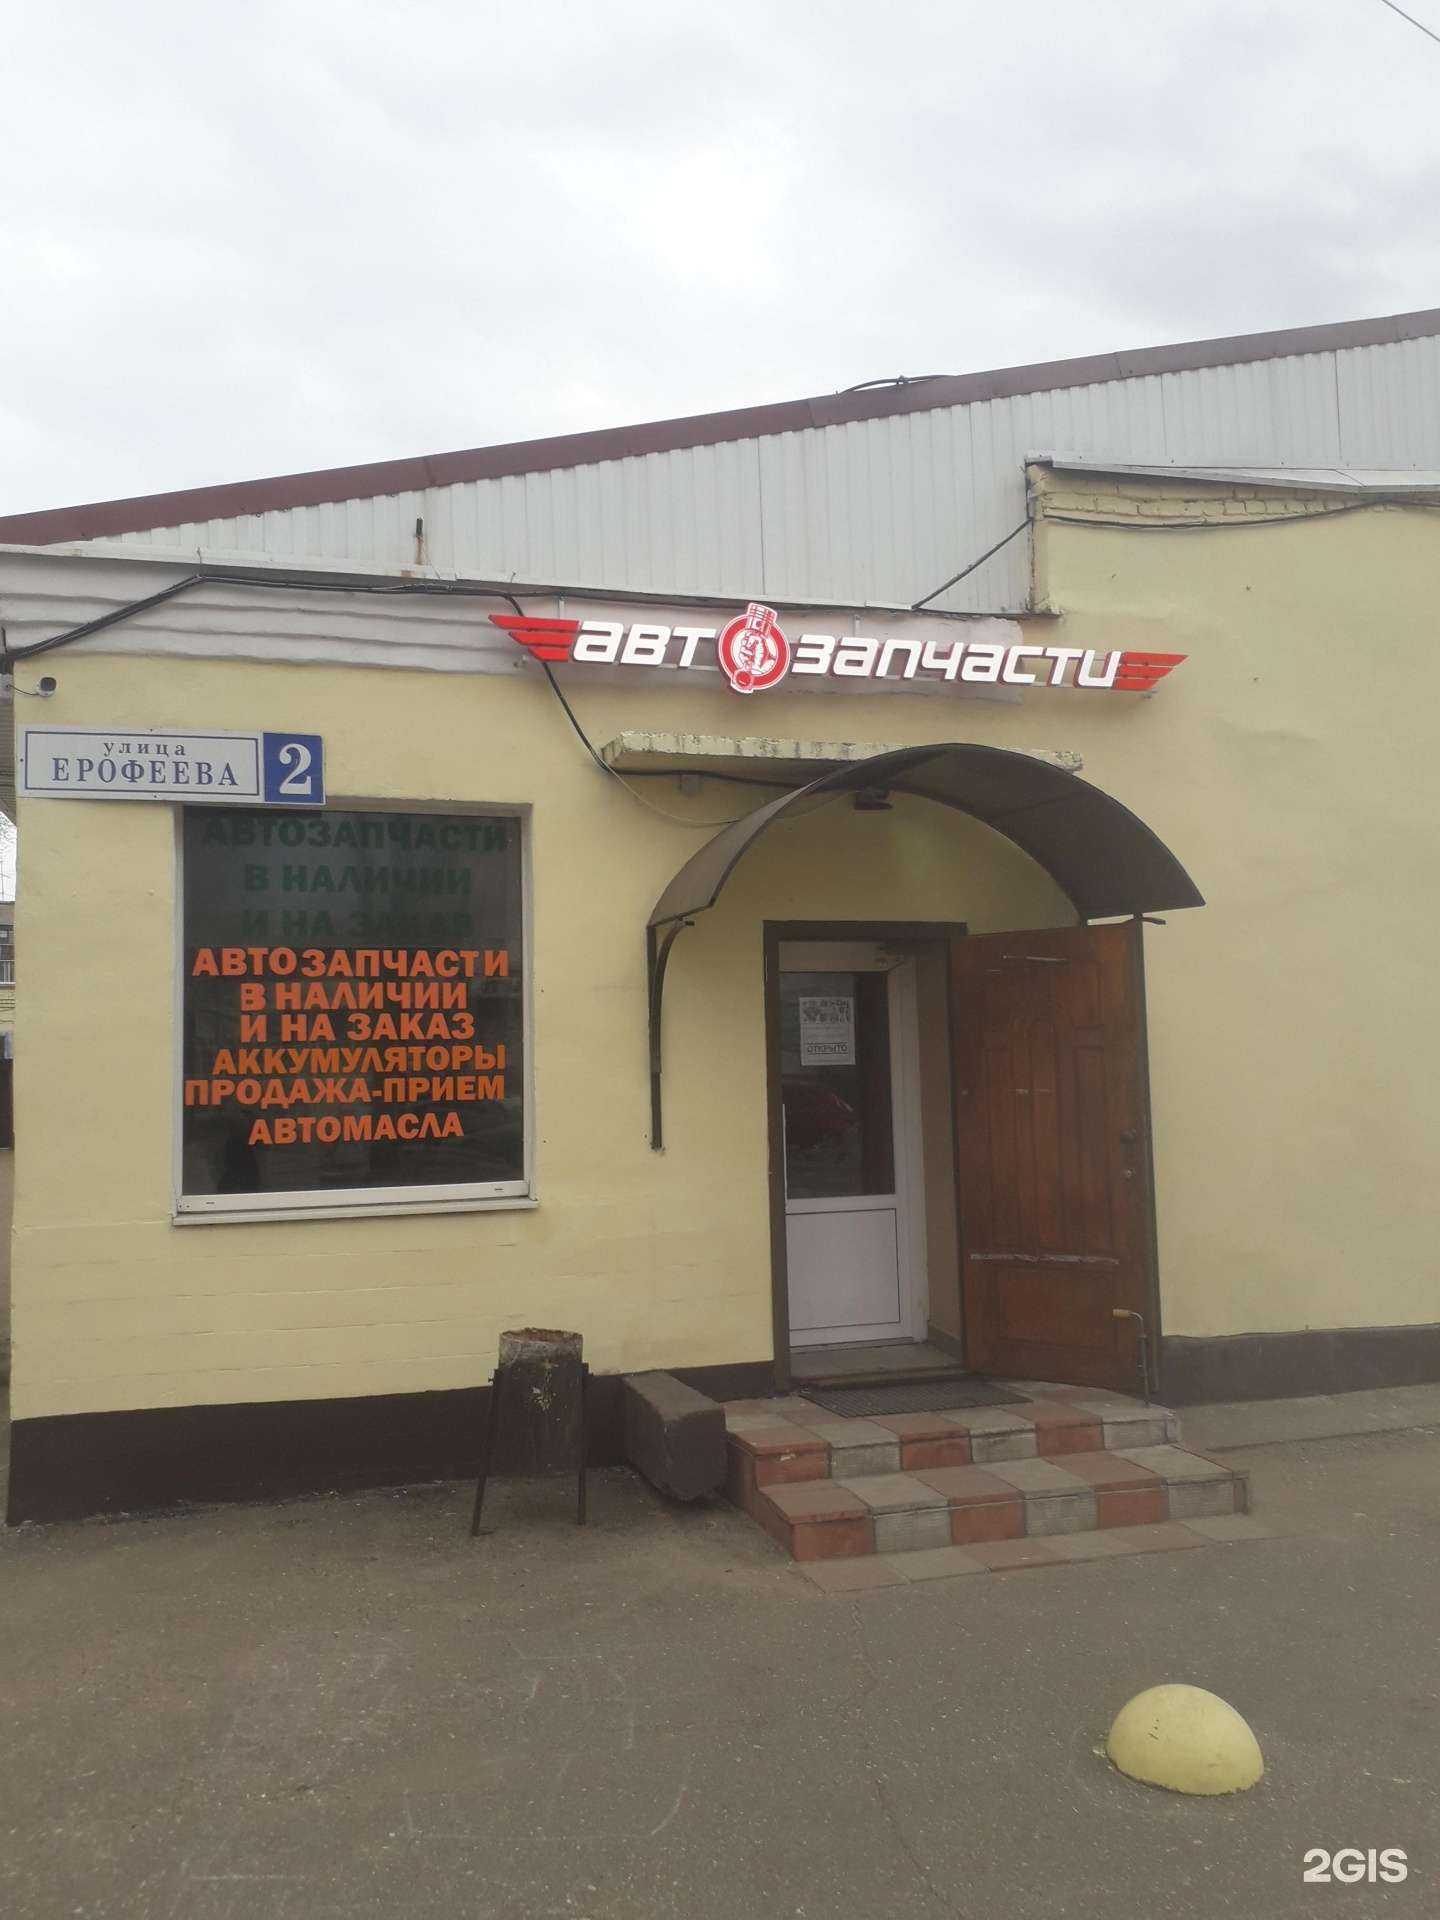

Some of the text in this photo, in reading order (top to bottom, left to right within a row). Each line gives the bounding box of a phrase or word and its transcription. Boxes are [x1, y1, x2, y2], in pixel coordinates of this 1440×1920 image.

[104, 742, 186, 757] улица
[52, 758, 239, 787] ЕРОФЕЕВА
[279, 743, 312, 795] 2
[193, 947, 509, 978] АВТОЗАПЧАСТИ
[240, 982, 468, 1012] В НАЛИЧИИ
[240, 1013, 475, 1043] И НА ЗАКАЗ
[212, 1044, 507, 1076] АККУМУЛЯТОРЫ
[185, 1074, 506, 1109] ПРОДАЖА-ПРИЕМ
[249, 1111, 464, 1146] АВТОМАСЛА
